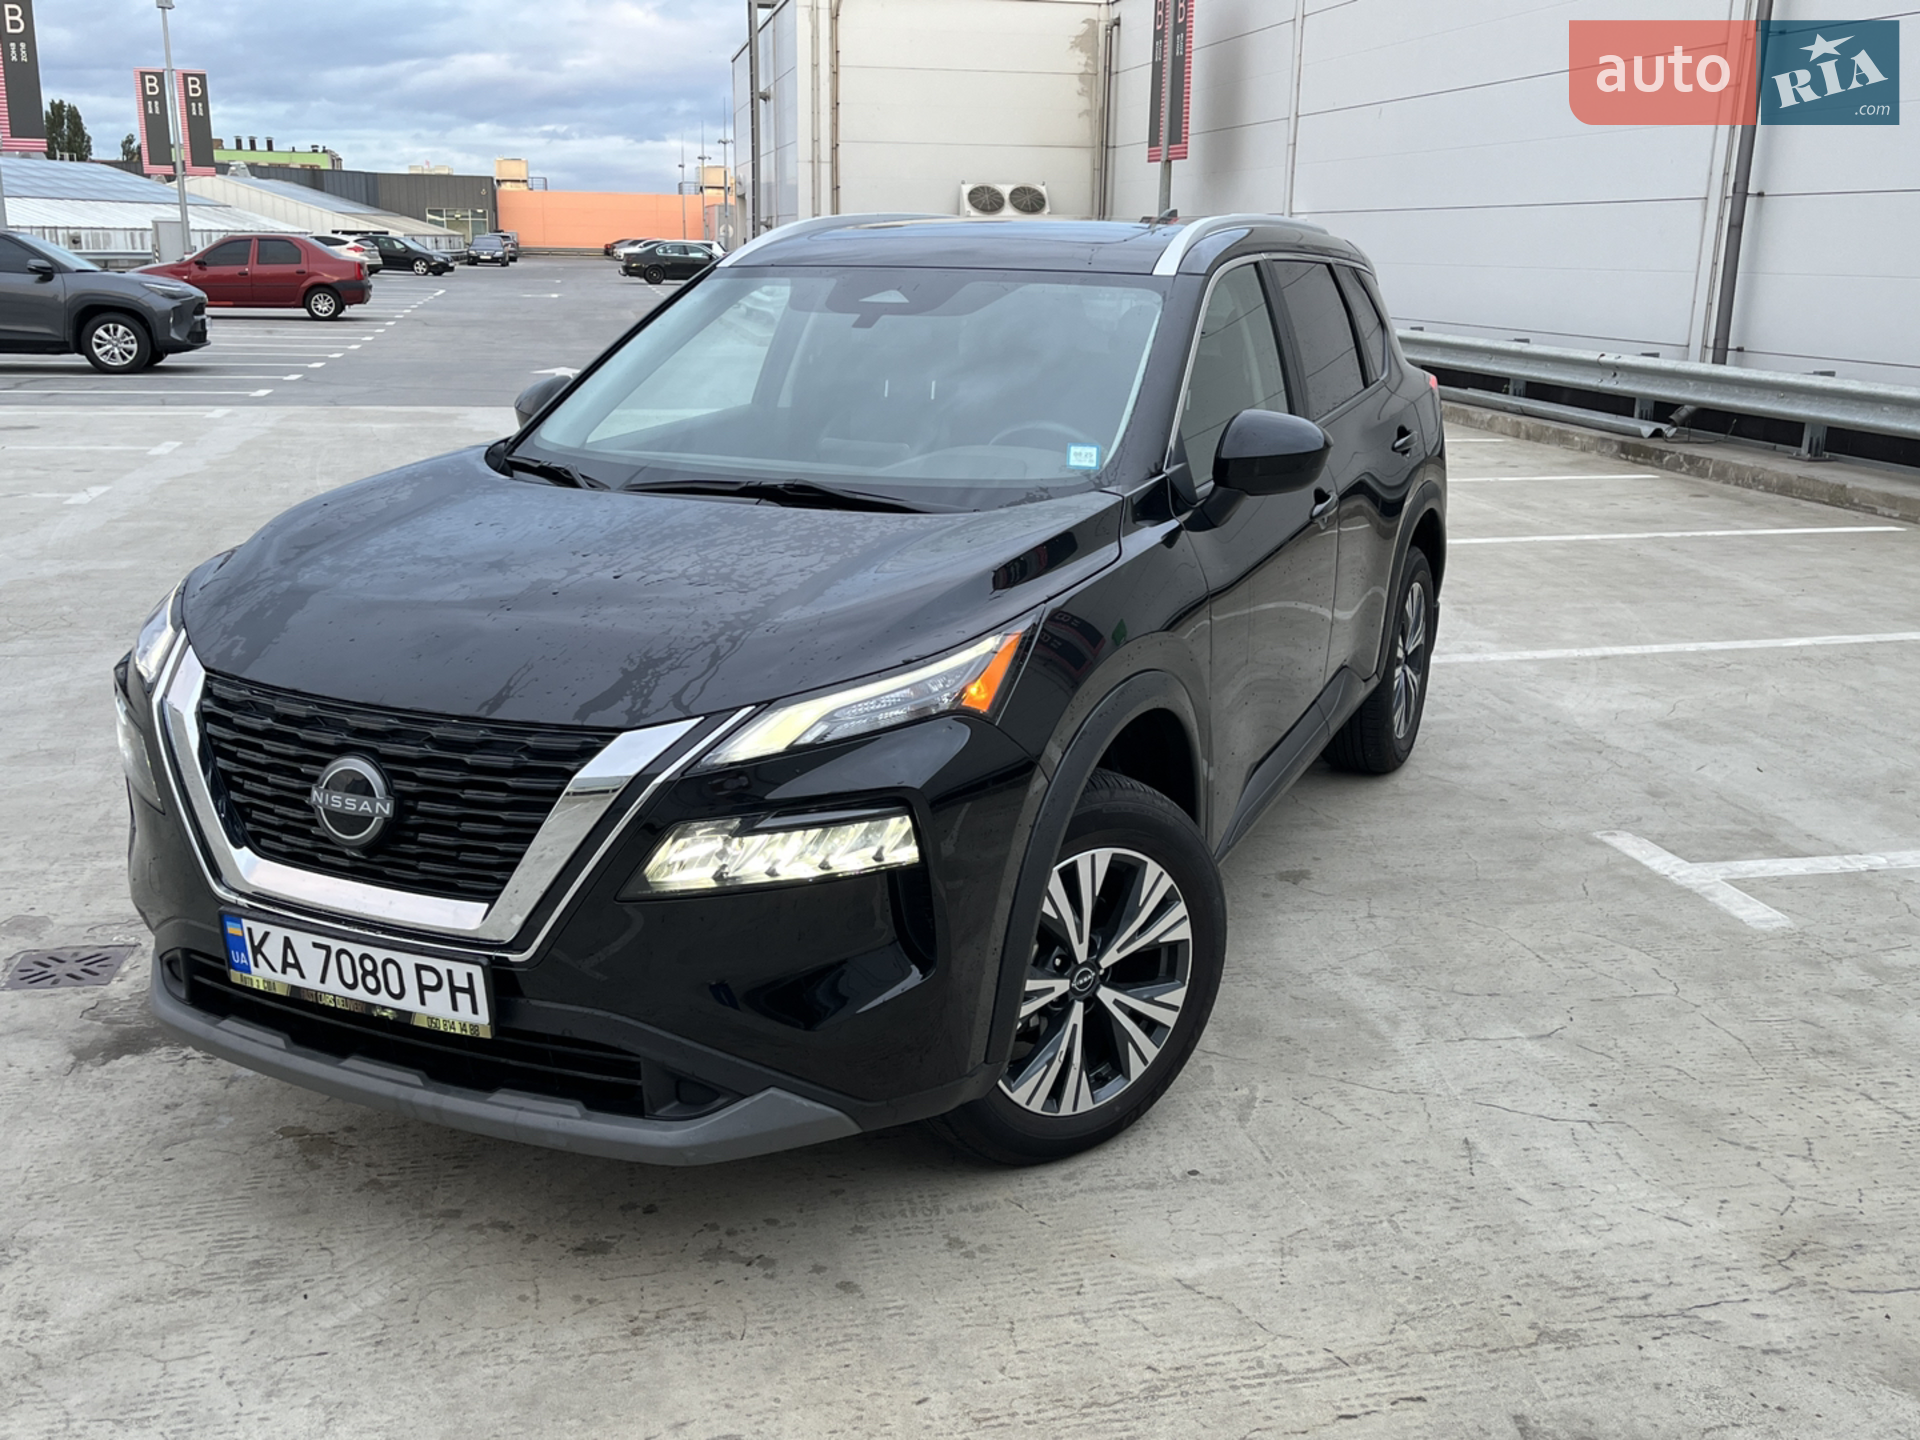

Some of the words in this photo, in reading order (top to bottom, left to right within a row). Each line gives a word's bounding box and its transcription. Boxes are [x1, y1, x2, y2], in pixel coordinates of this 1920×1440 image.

[4, 4, 25, 33] B
[145, 75, 159, 95] B
[188, 77, 202, 97] B
[312, 790, 391, 815] NISSAN
[231, 950, 249, 966] UA
[247, 926, 306, 980] KA
[311, 941, 406, 1001] 7080
[414, 963, 480, 1016] PH
[318, 991, 336, 1007] CARS
[335, 995, 366, 1014] DELIVERY
